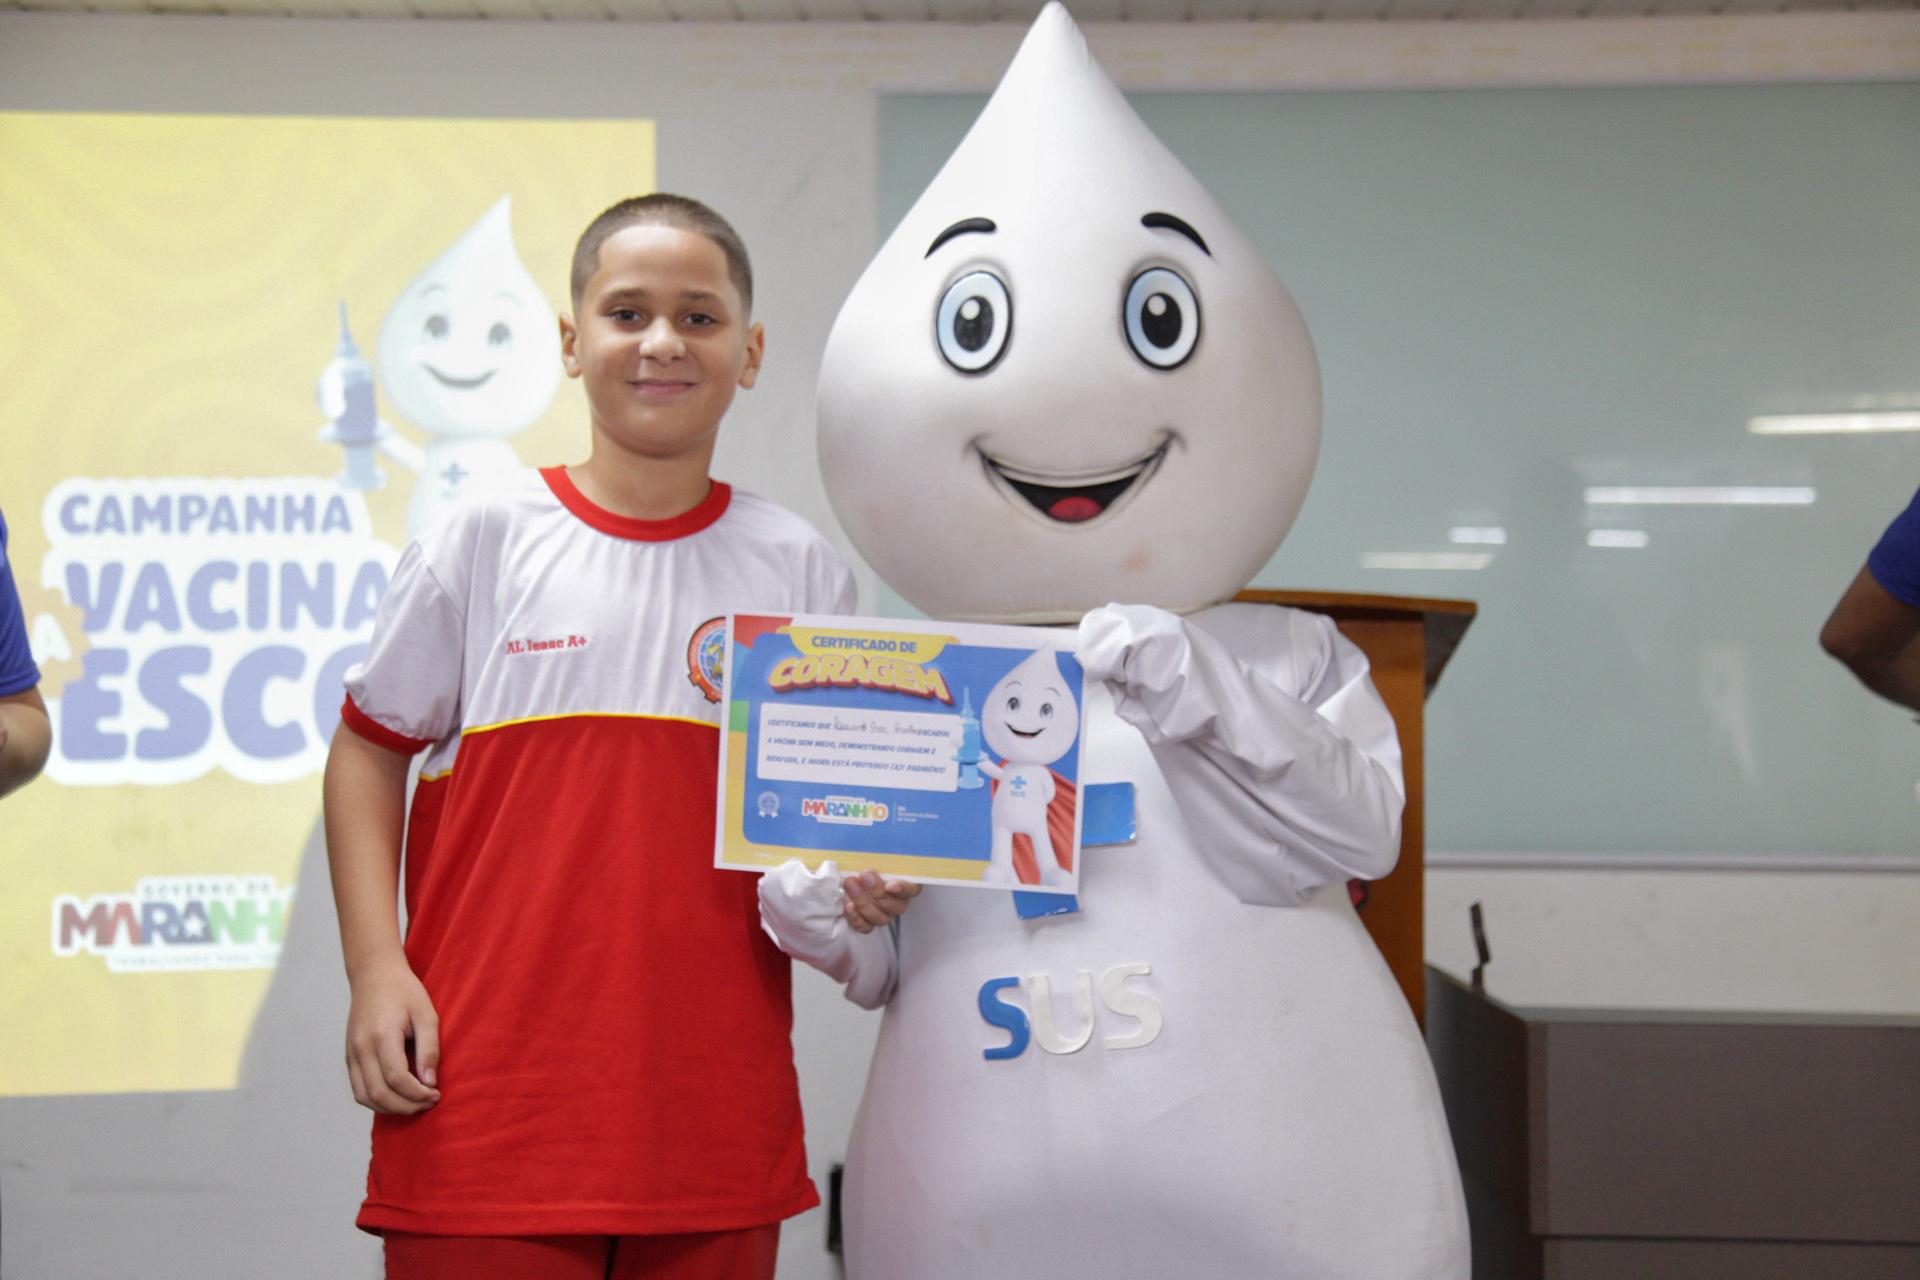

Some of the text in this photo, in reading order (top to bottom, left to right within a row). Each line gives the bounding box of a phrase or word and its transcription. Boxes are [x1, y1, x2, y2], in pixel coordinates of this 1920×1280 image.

[59, 494, 353, 535] CAMPANHA
[812, 635, 917, 653] CERTIFICADO DE
[768, 654, 952, 703] CORAGEM
[831, 758, 849, 767] ESTÁ
[60, 900, 287, 948] MARANH
[978, 962, 1164, 1061] SUS
